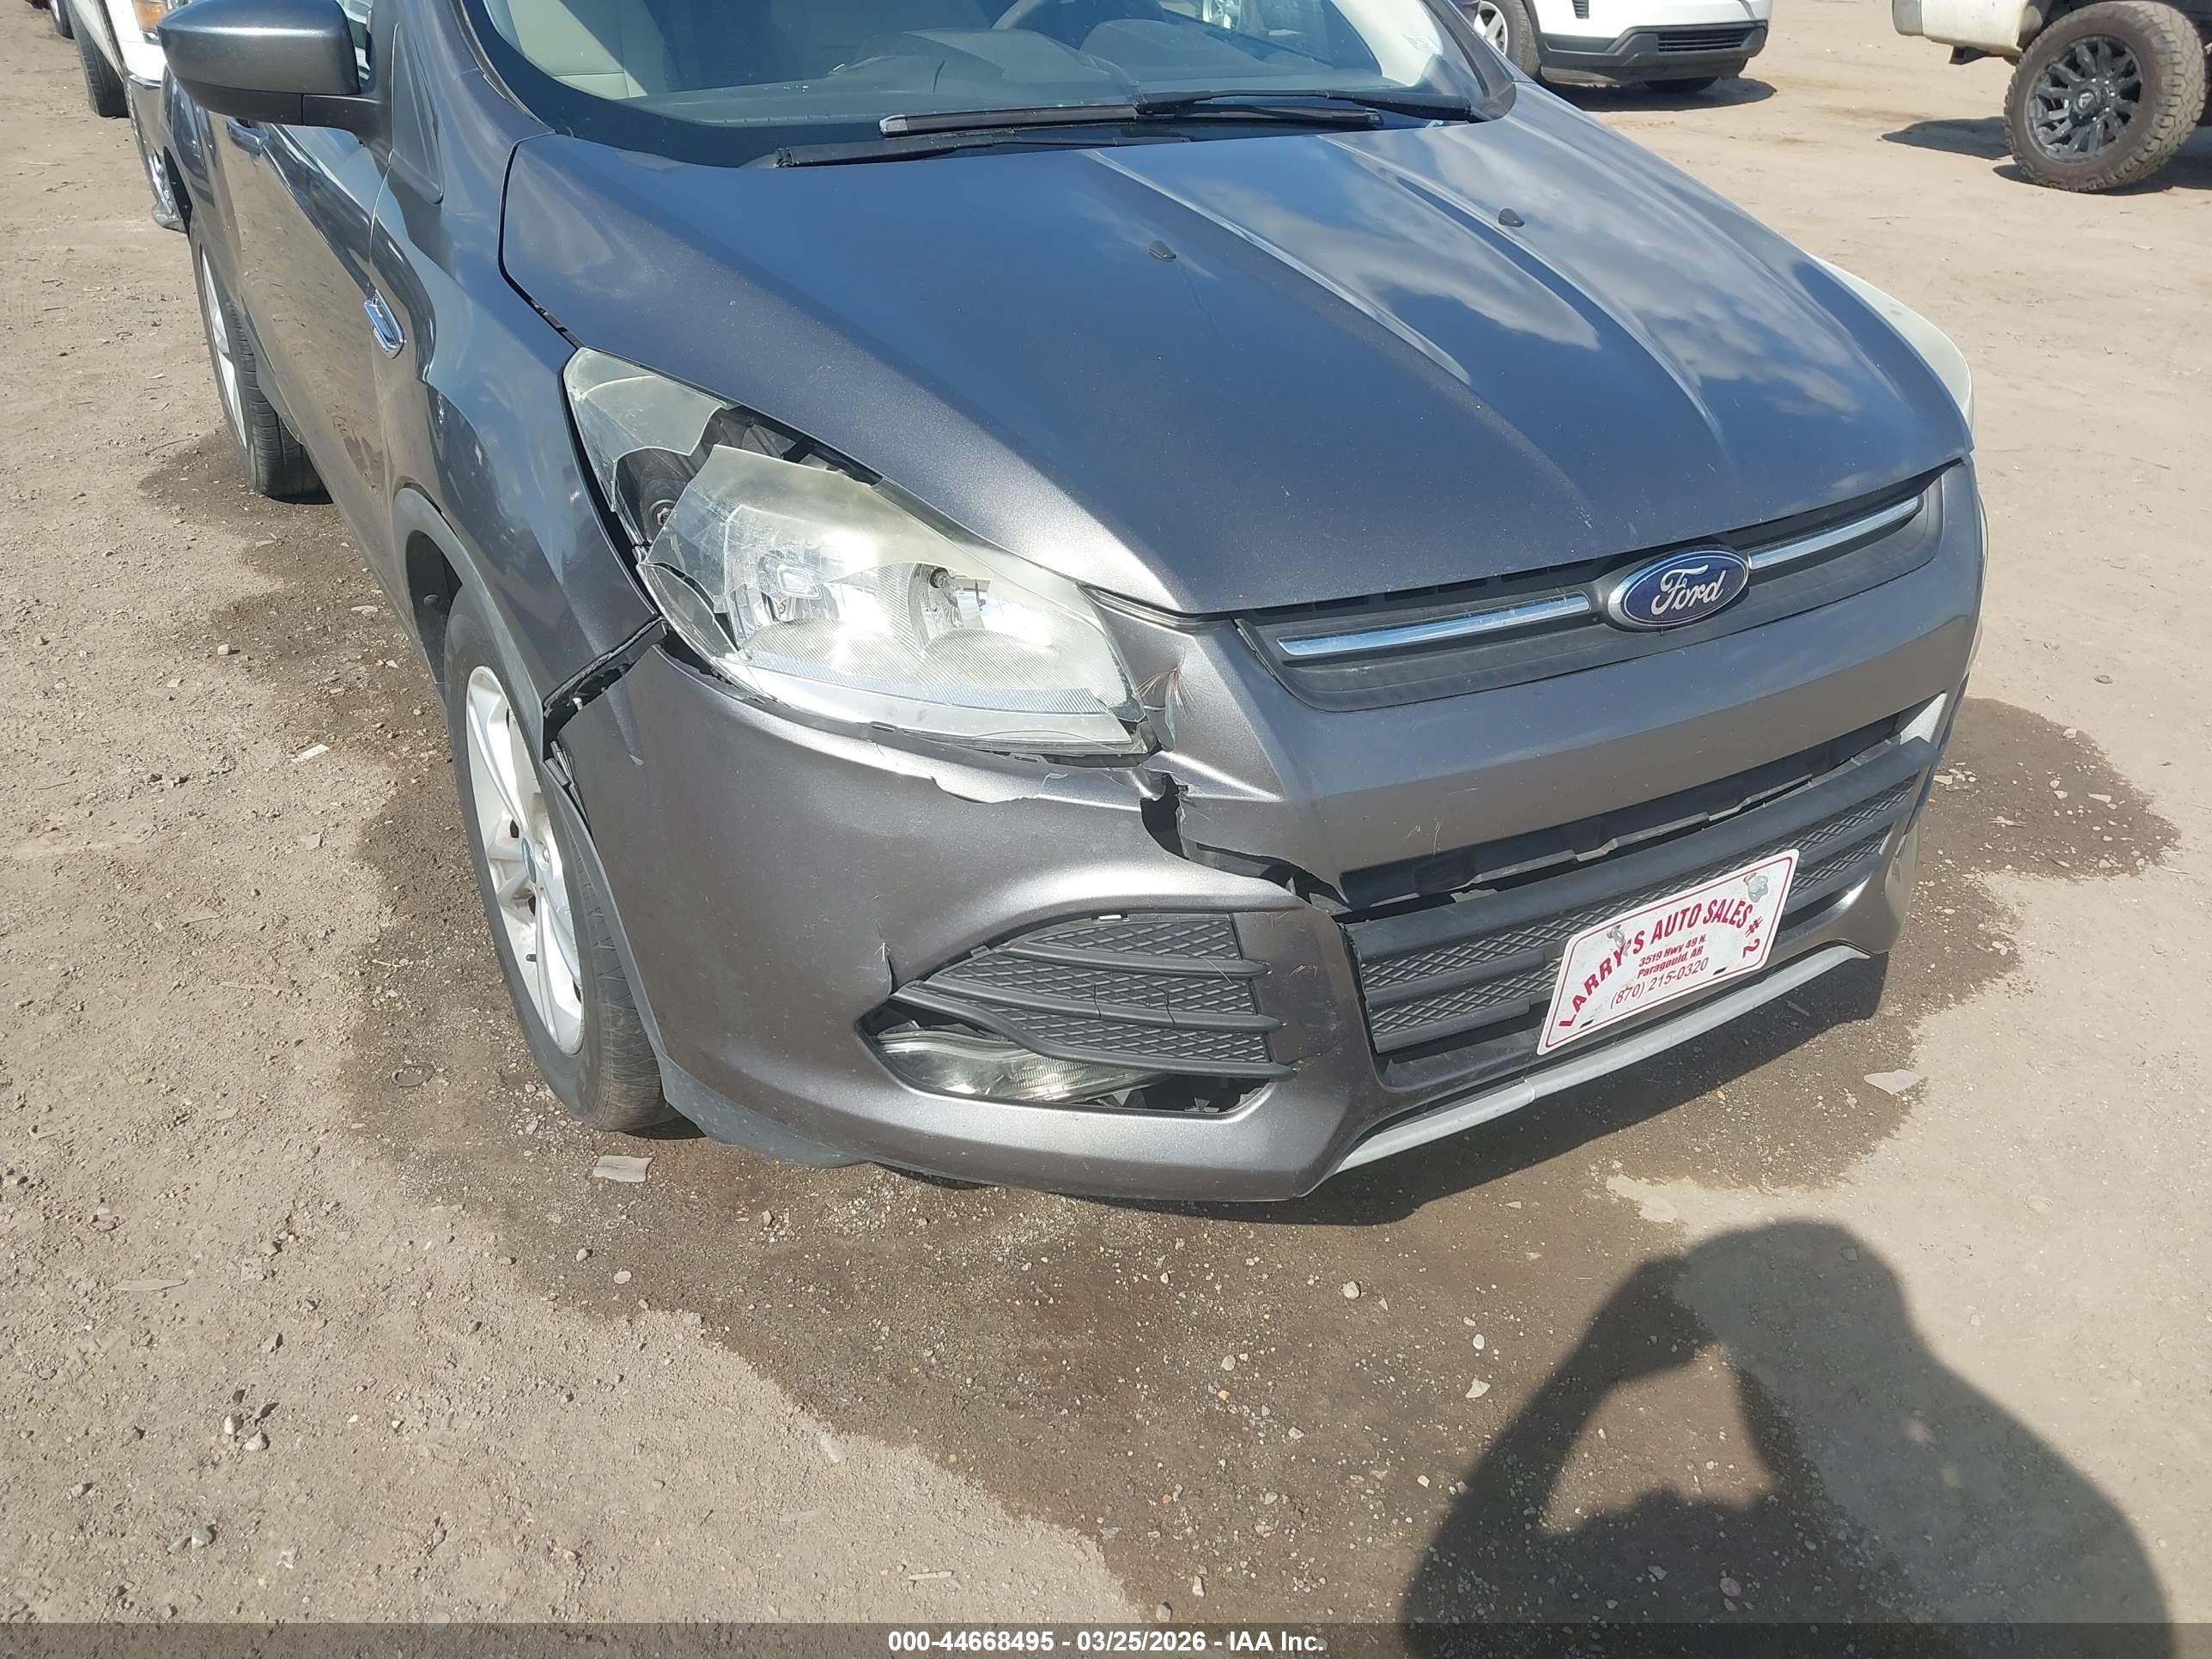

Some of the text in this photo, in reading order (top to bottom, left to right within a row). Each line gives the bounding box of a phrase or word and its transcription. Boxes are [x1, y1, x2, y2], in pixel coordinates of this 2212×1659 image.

[1651, 564, 1726, 615] Ford
[1559, 930, 1645, 1027] LARRY'S
[1650, 903, 1702, 945] AUTO
[1703, 898, 1753, 929] SALES
[1742, 938, 1760, 958] 2
[1638, 951, 1663, 967] 3519
[1664, 943, 1685, 959] Hwy
[1686, 938, 1699, 950] 49
[1690, 945, 1704, 959] AR
[1610, 957, 1710, 1010] (870) 215-0320
